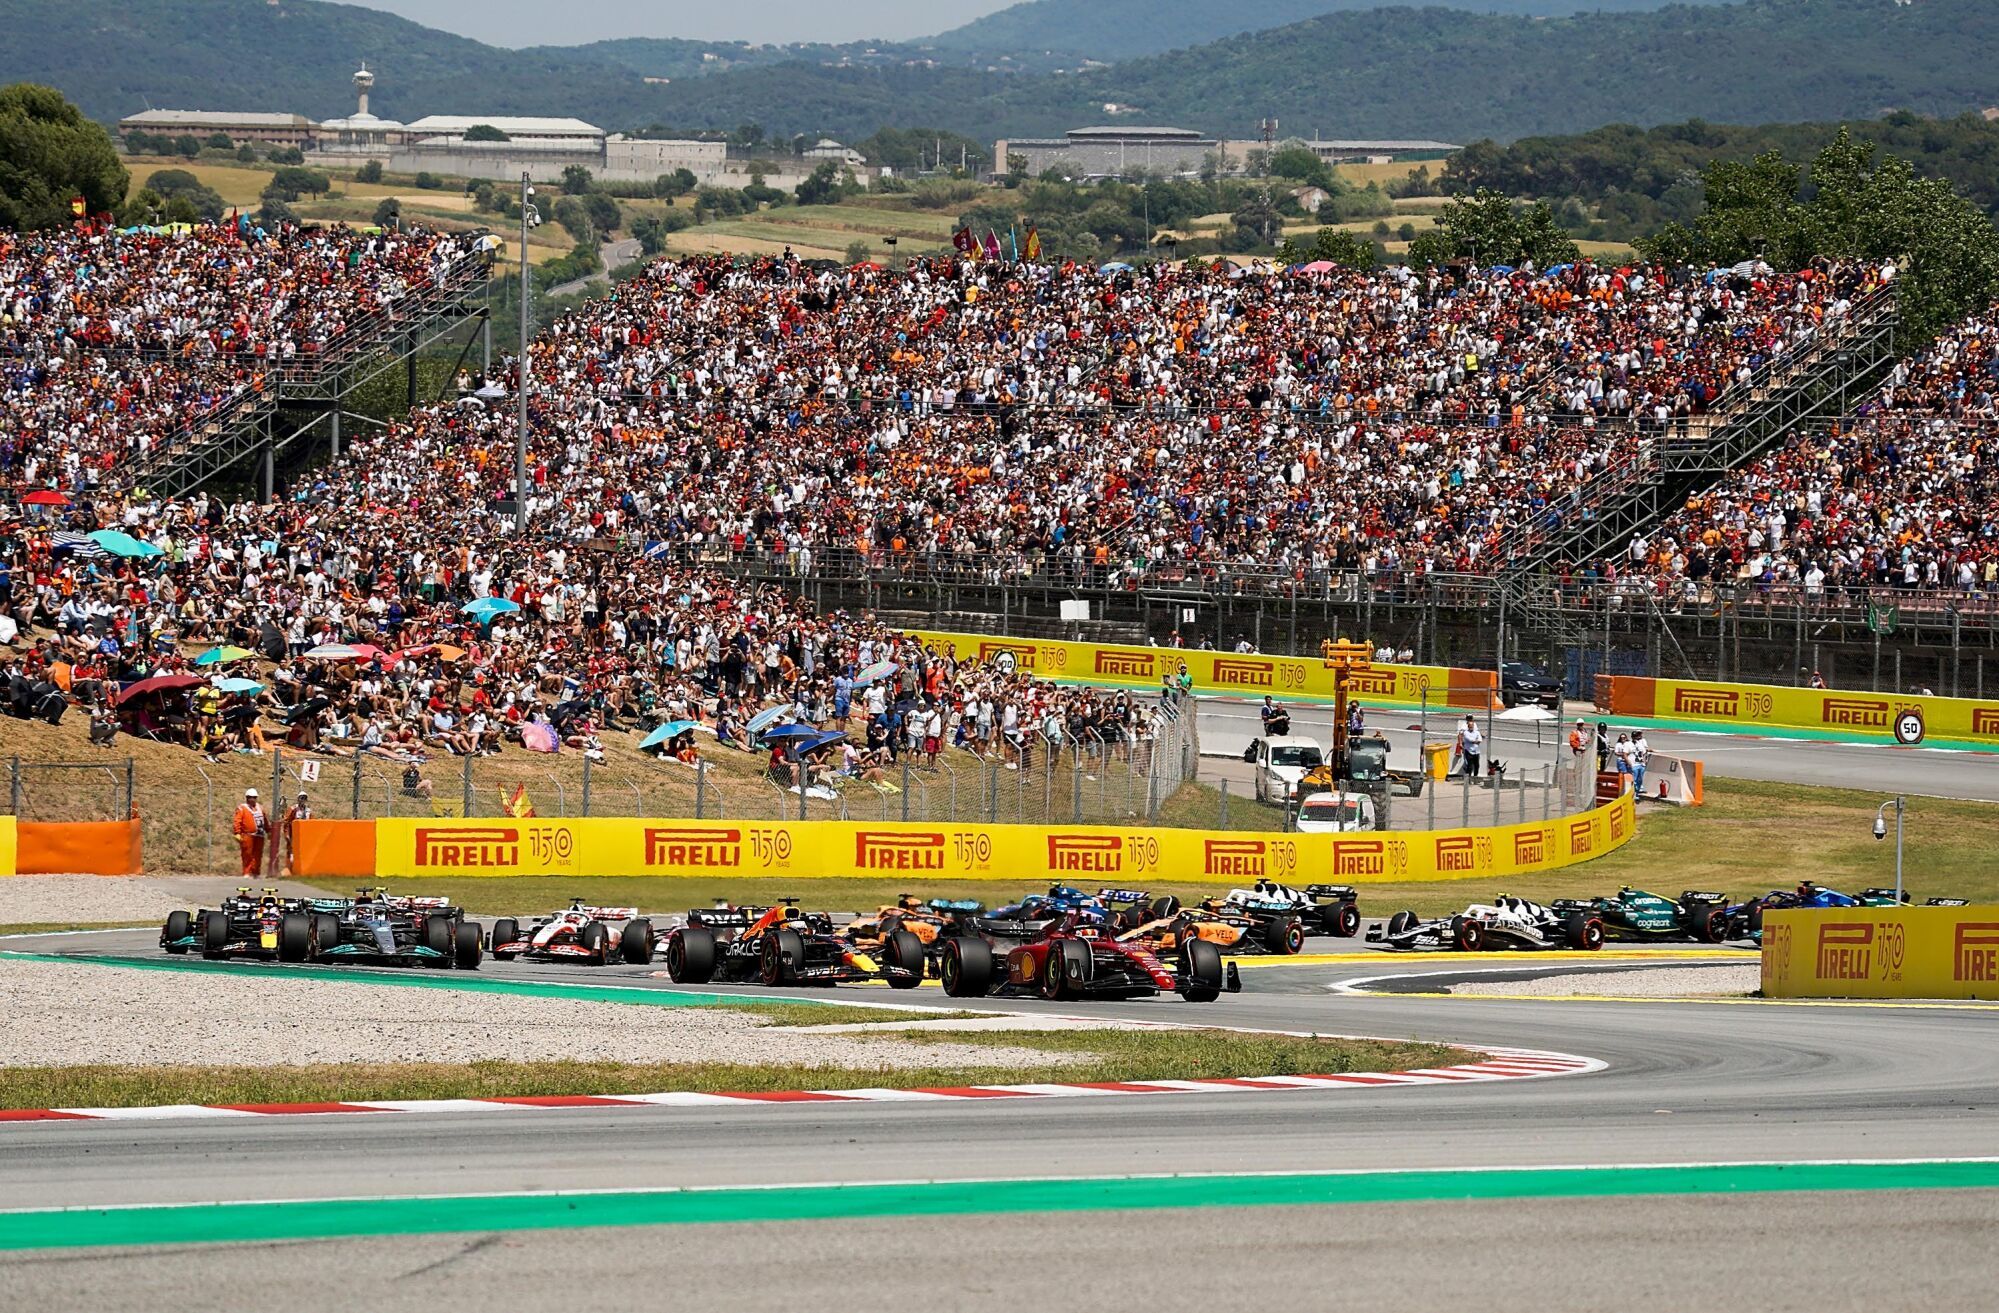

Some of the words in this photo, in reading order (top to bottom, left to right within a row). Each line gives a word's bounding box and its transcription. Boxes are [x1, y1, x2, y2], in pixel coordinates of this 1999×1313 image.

[1041, 647, 1066, 670] 150
[1095, 651, 1154, 676] PIRELLI
[1213, 659, 1274, 686] PIRELLI
[1280, 663, 1306, 688] 150
[1403, 672, 1431, 697] 150
[1675, 688, 1739, 716] PIRELLI
[1745, 692, 1773, 718] 150
[1823, 698, 1889, 726] PIRELLI
[1903, 723, 1918, 734] 50
[415, 828, 519, 866] PIRELLI
[529, 828, 572, 865] 150
[645, 829, 741, 866] PIRELLI
[751, 829, 791, 867] 150
[856, 831, 945, 869] PIRELLI
[954, 833, 992, 870] 150
[1048, 835, 1122, 871] PIRELLI
[1128, 836, 1160, 872] 150
[1204, 839, 1266, 875] PIRELLI
[1271, 841, 1297, 876] 150
[1333, 841, 1384, 875] PIRELLI
[1388, 840, 1409, 875] 150
[1436, 836, 1474, 871] PIRELLI
[1514, 831, 1543, 865] PIRELLI
[1637, 917, 1670, 929] cognizant
[1816, 923, 1874, 979] PIRELLI
[1878, 923, 1905, 981] 150
